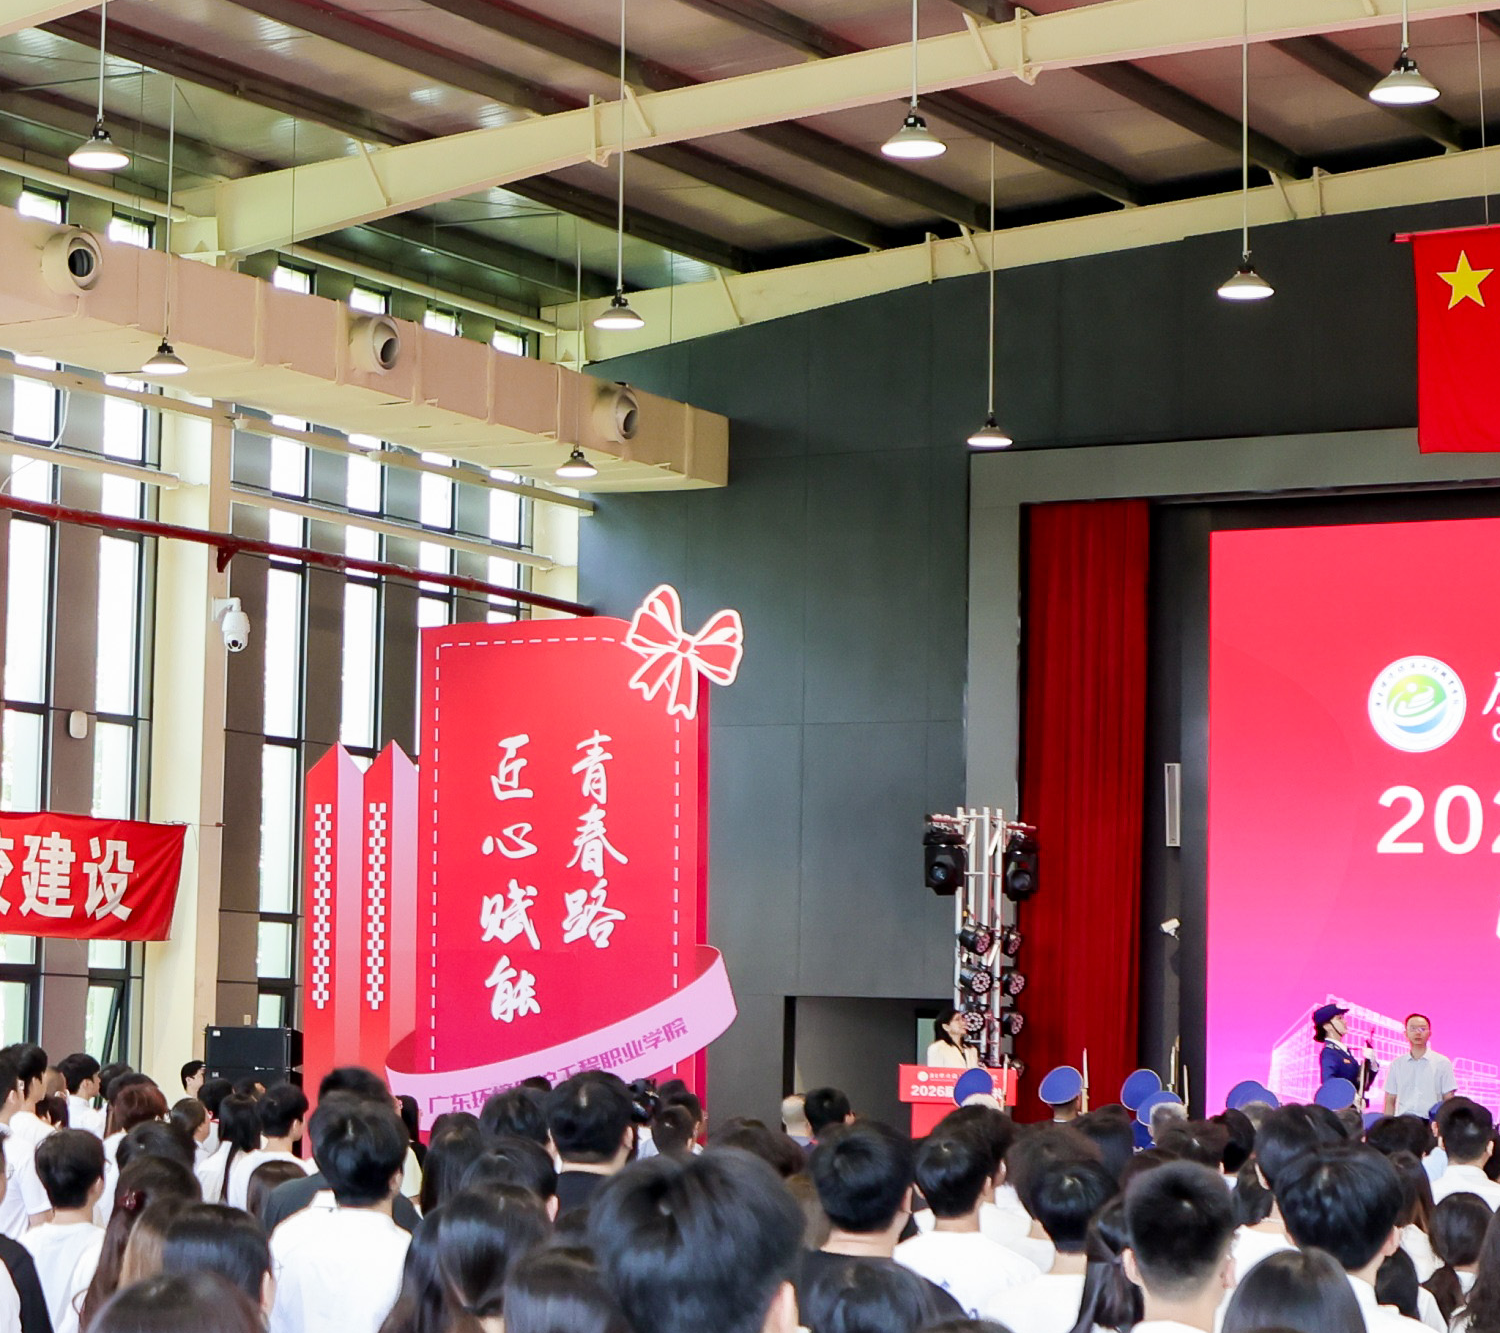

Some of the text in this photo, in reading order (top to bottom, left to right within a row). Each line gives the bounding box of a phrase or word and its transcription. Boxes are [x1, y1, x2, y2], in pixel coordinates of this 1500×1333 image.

[479, 732, 543, 1025] 匠心赋能
[561, 728, 629, 949] 青春路
